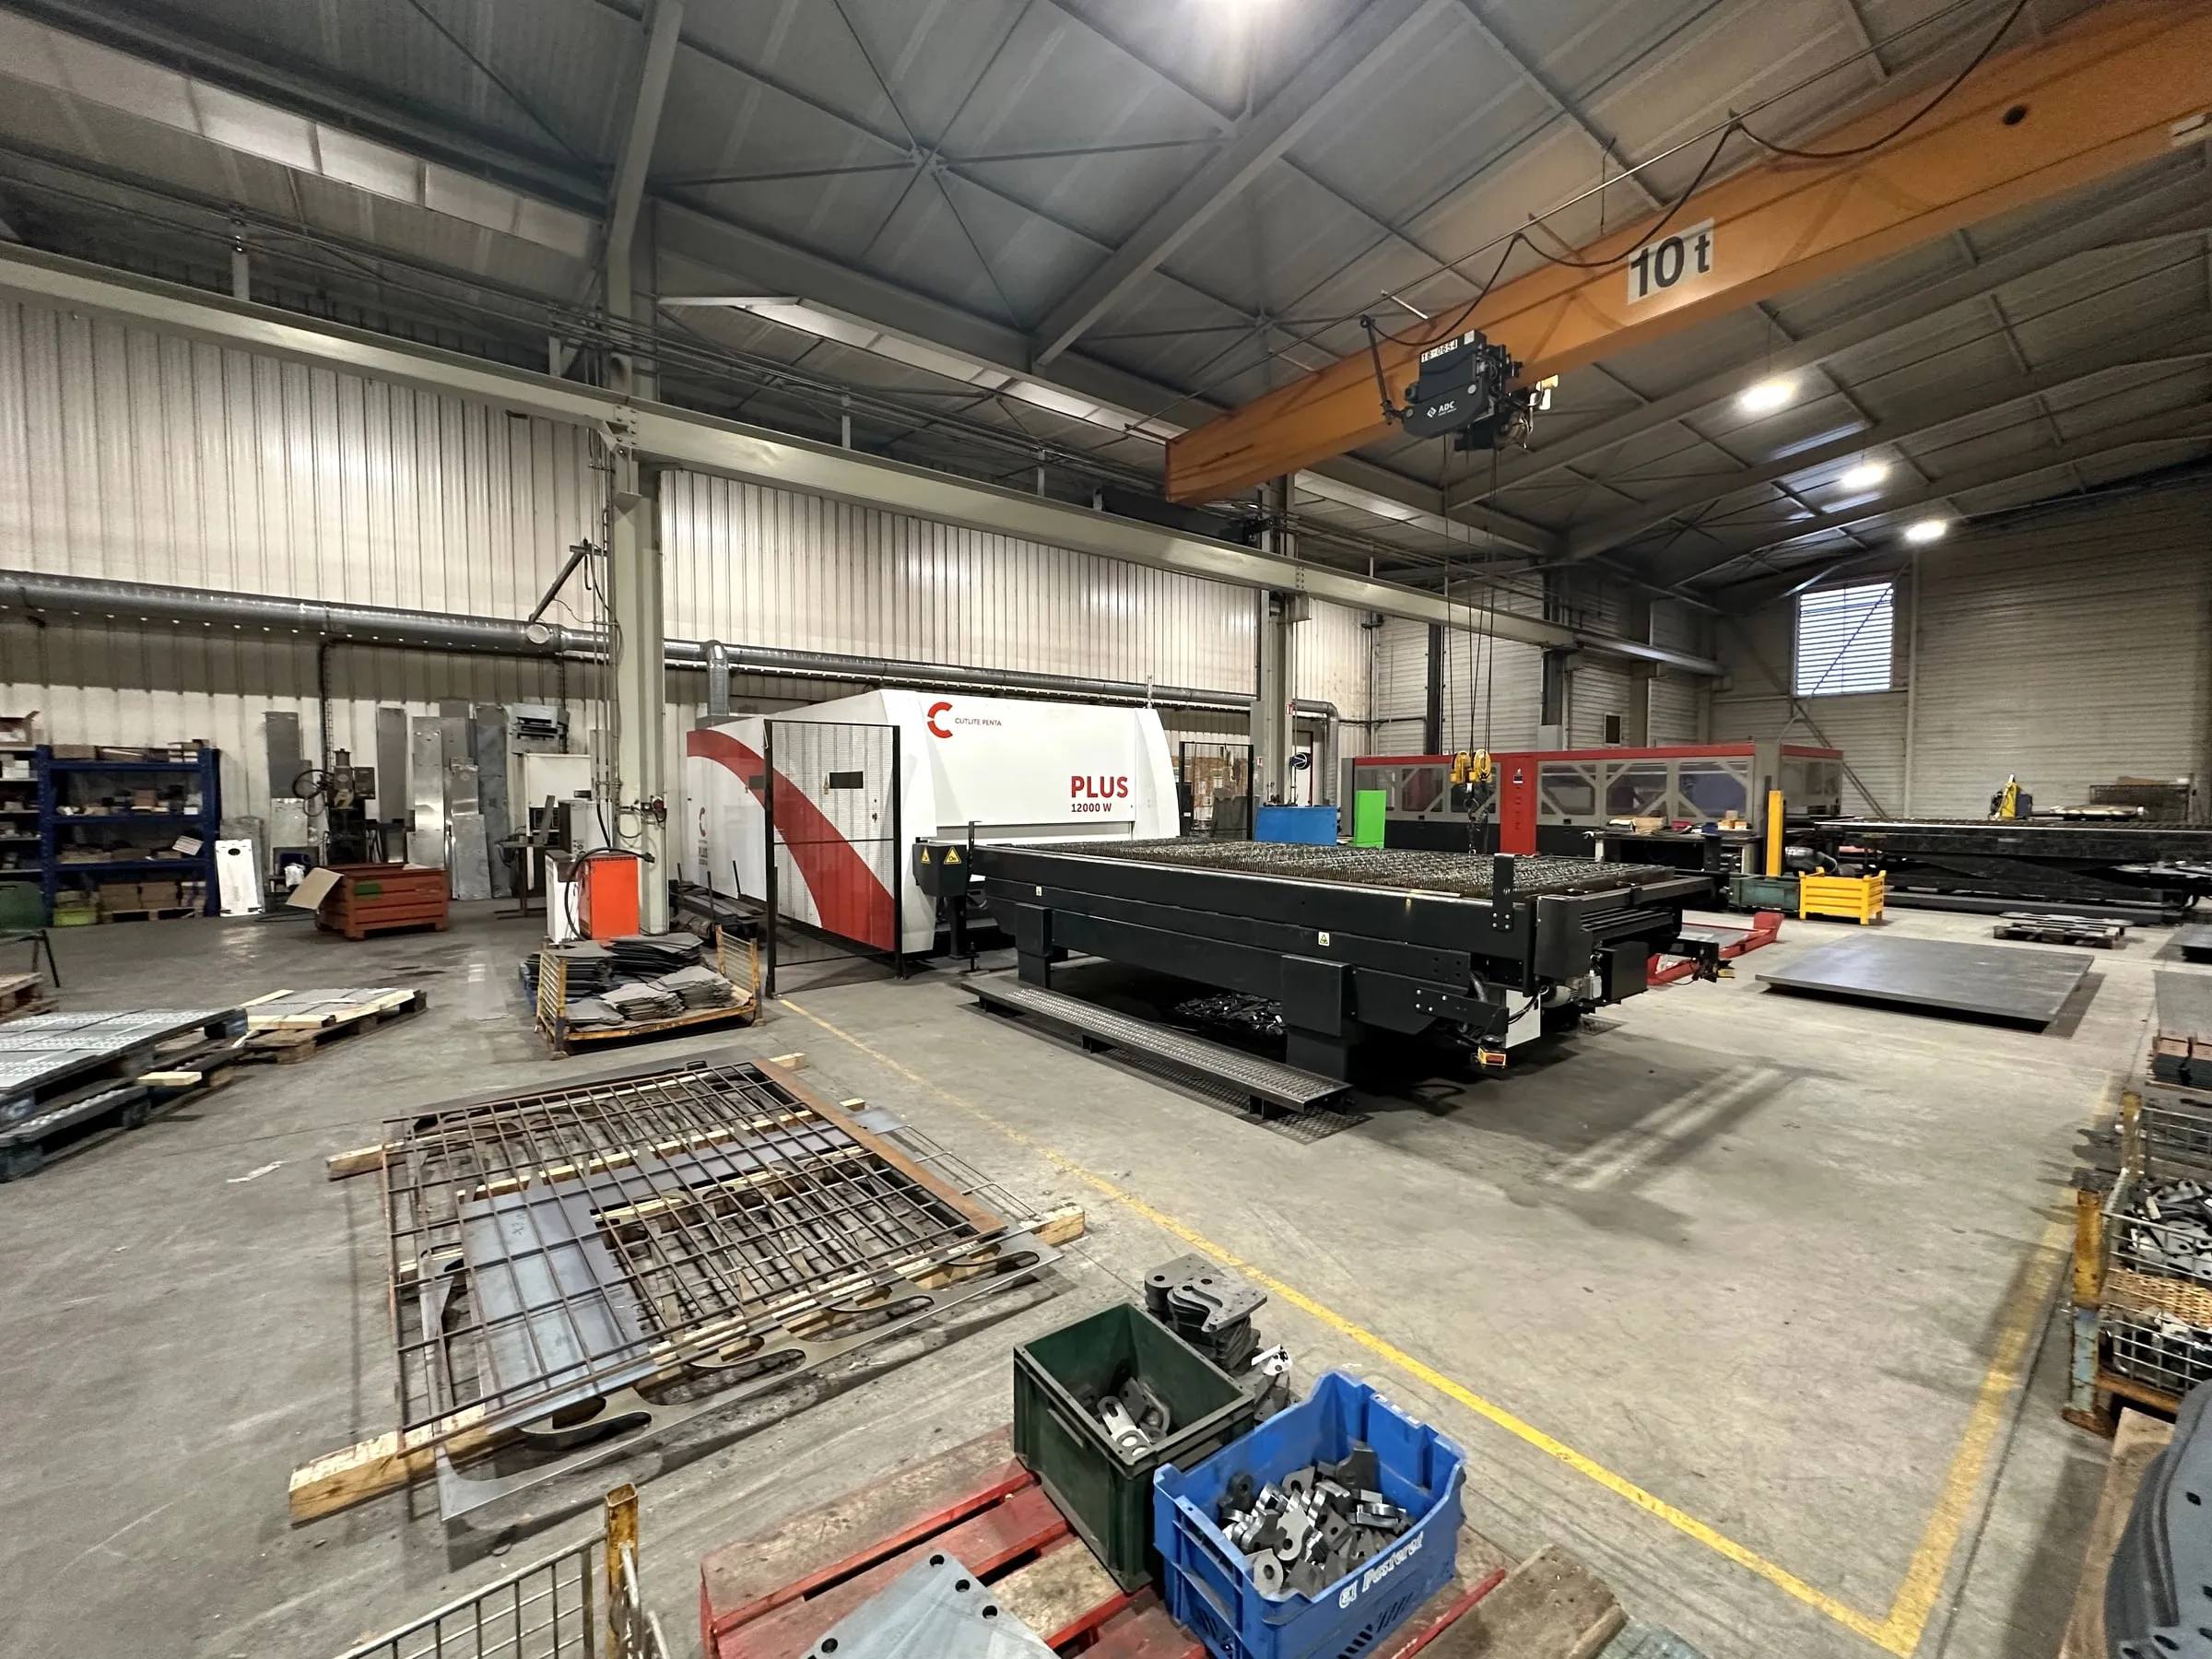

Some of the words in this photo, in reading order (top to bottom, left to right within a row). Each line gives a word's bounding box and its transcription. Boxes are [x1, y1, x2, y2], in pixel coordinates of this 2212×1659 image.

[1630, 236, 1684, 297] 10
[1694, 234, 1710, 273] t
[1439, 400, 1454, 413] ADC
[954, 717, 981, 725] CUTLITE
[1071, 776, 1128, 798] PLUS
[1071, 803, 1100, 812] 12000
[1102, 803, 1112, 812] W
